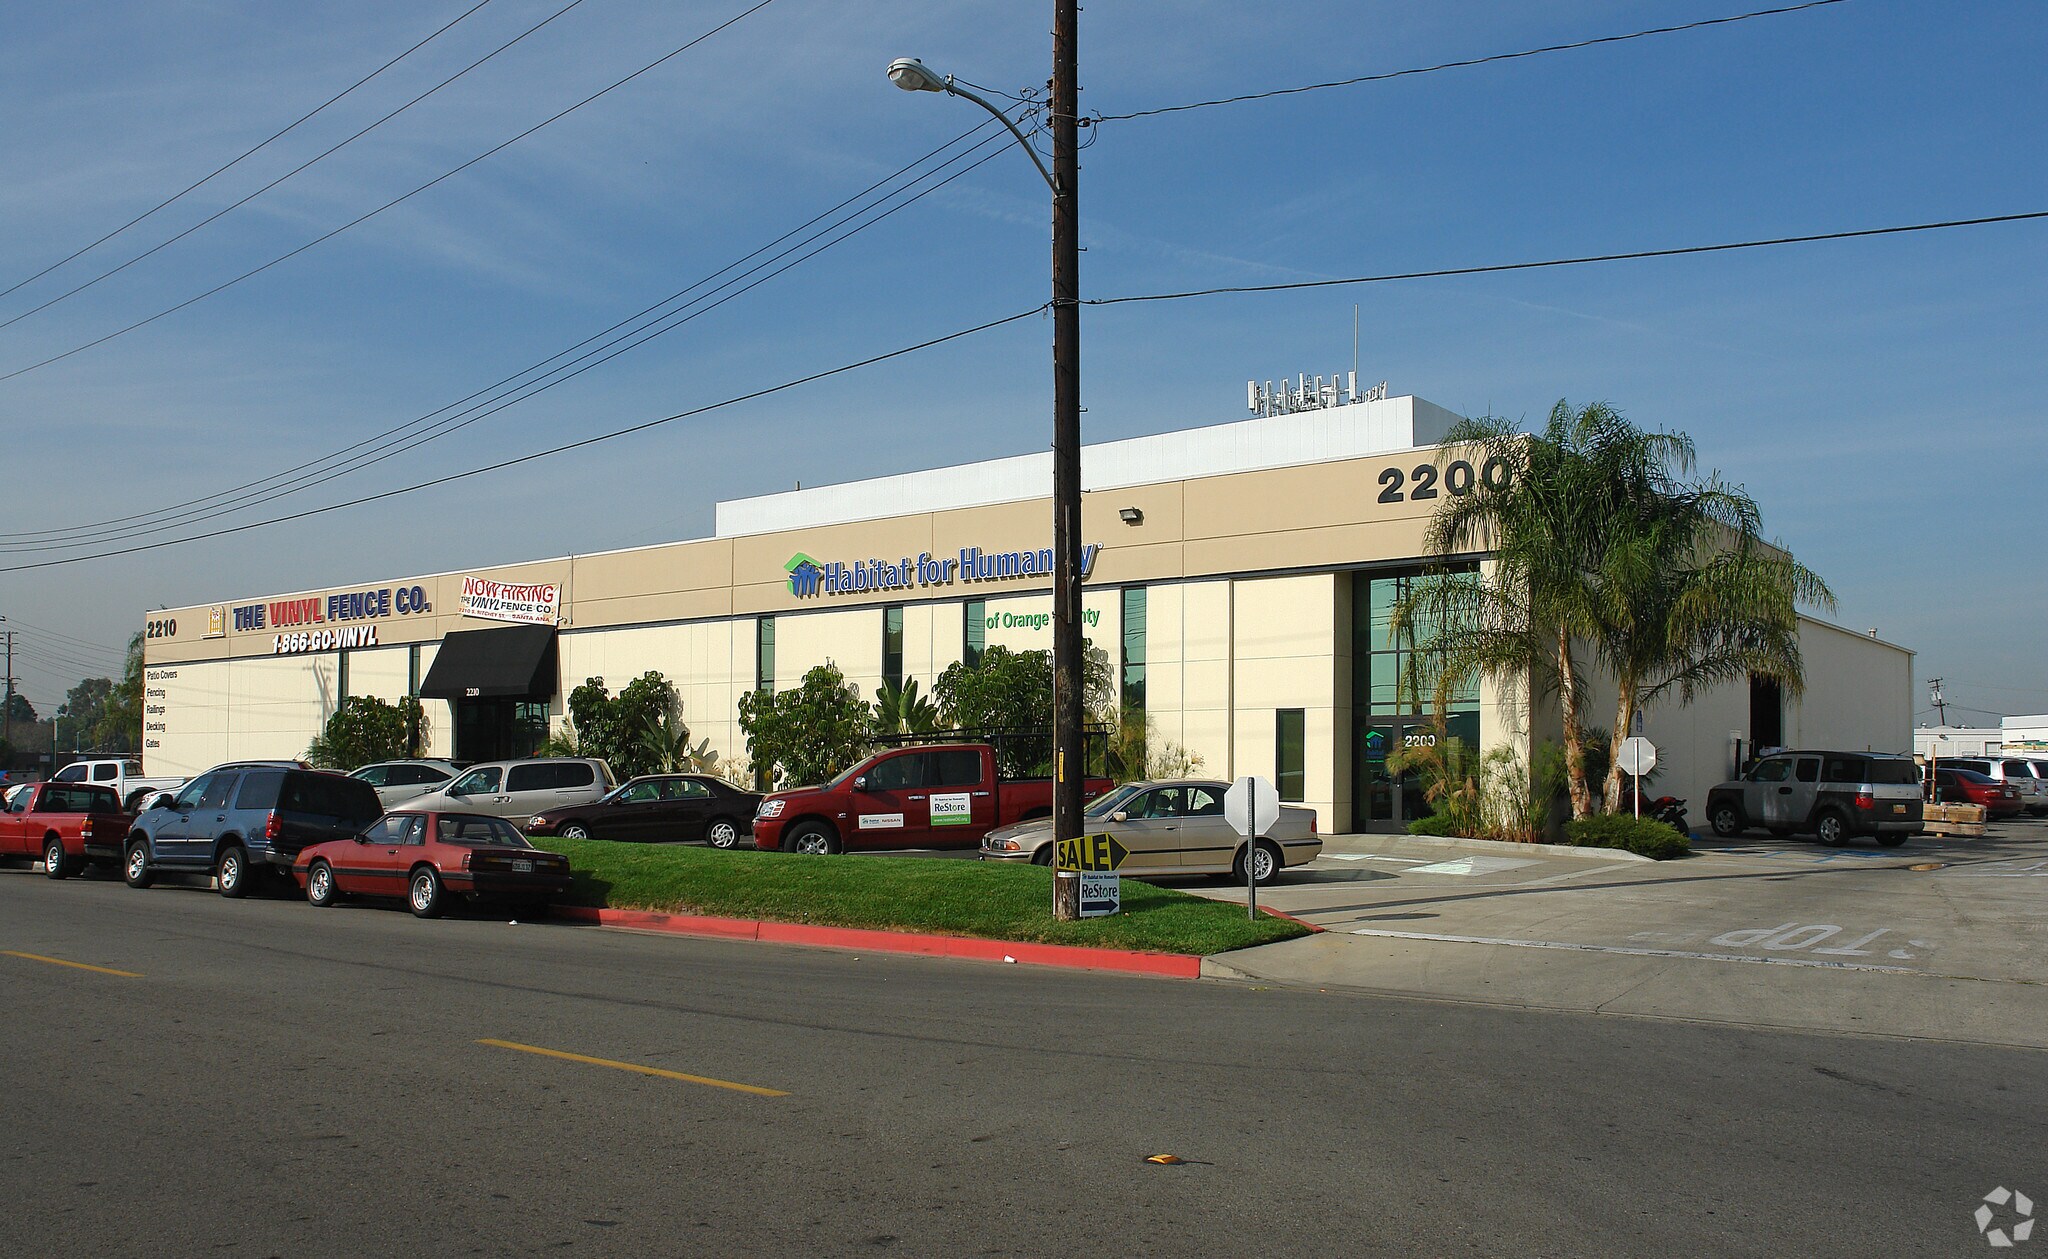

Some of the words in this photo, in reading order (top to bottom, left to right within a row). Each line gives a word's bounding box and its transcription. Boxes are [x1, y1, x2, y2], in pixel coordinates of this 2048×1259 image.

[1377, 455, 1511, 504] 2200
[823, 557, 910, 592] Habitat
[916, 551, 955, 584] for
[959, 543, 1095, 581] Humany
[463, 577, 501, 598] NOW
[501, 584, 554, 603] HIRING
[232, 603, 266, 631] THE
[269, 597, 324, 628] VINYL
[327, 589, 391, 622] FENCE
[395, 585, 431, 614] CO.
[460, 596, 471, 604] THE
[471, 596, 500, 611] VINYL
[500, 601, 533, 612] FENCE
[536, 604, 554, 614] CO.
[147, 618, 177, 639] 2210
[985, 612, 1000, 629] of
[1002, 611, 1050, 631] Orange
[272, 625, 378, 654] 1-866-GO-VINYL
[147, 671, 160, 681] Patio
[160, 670, 178, 680] Covers
[146, 688, 166, 699] Fencing
[465, 687, 480, 697] 2210
[146, 705, 166, 716] Railings
[146, 722, 166, 733] Decking
[145, 738, 160, 748] Gates
[934, 802, 966, 812] ReStore
[1058, 833, 1110, 871] SALE
[1081, 883, 1118, 899] ReStore
